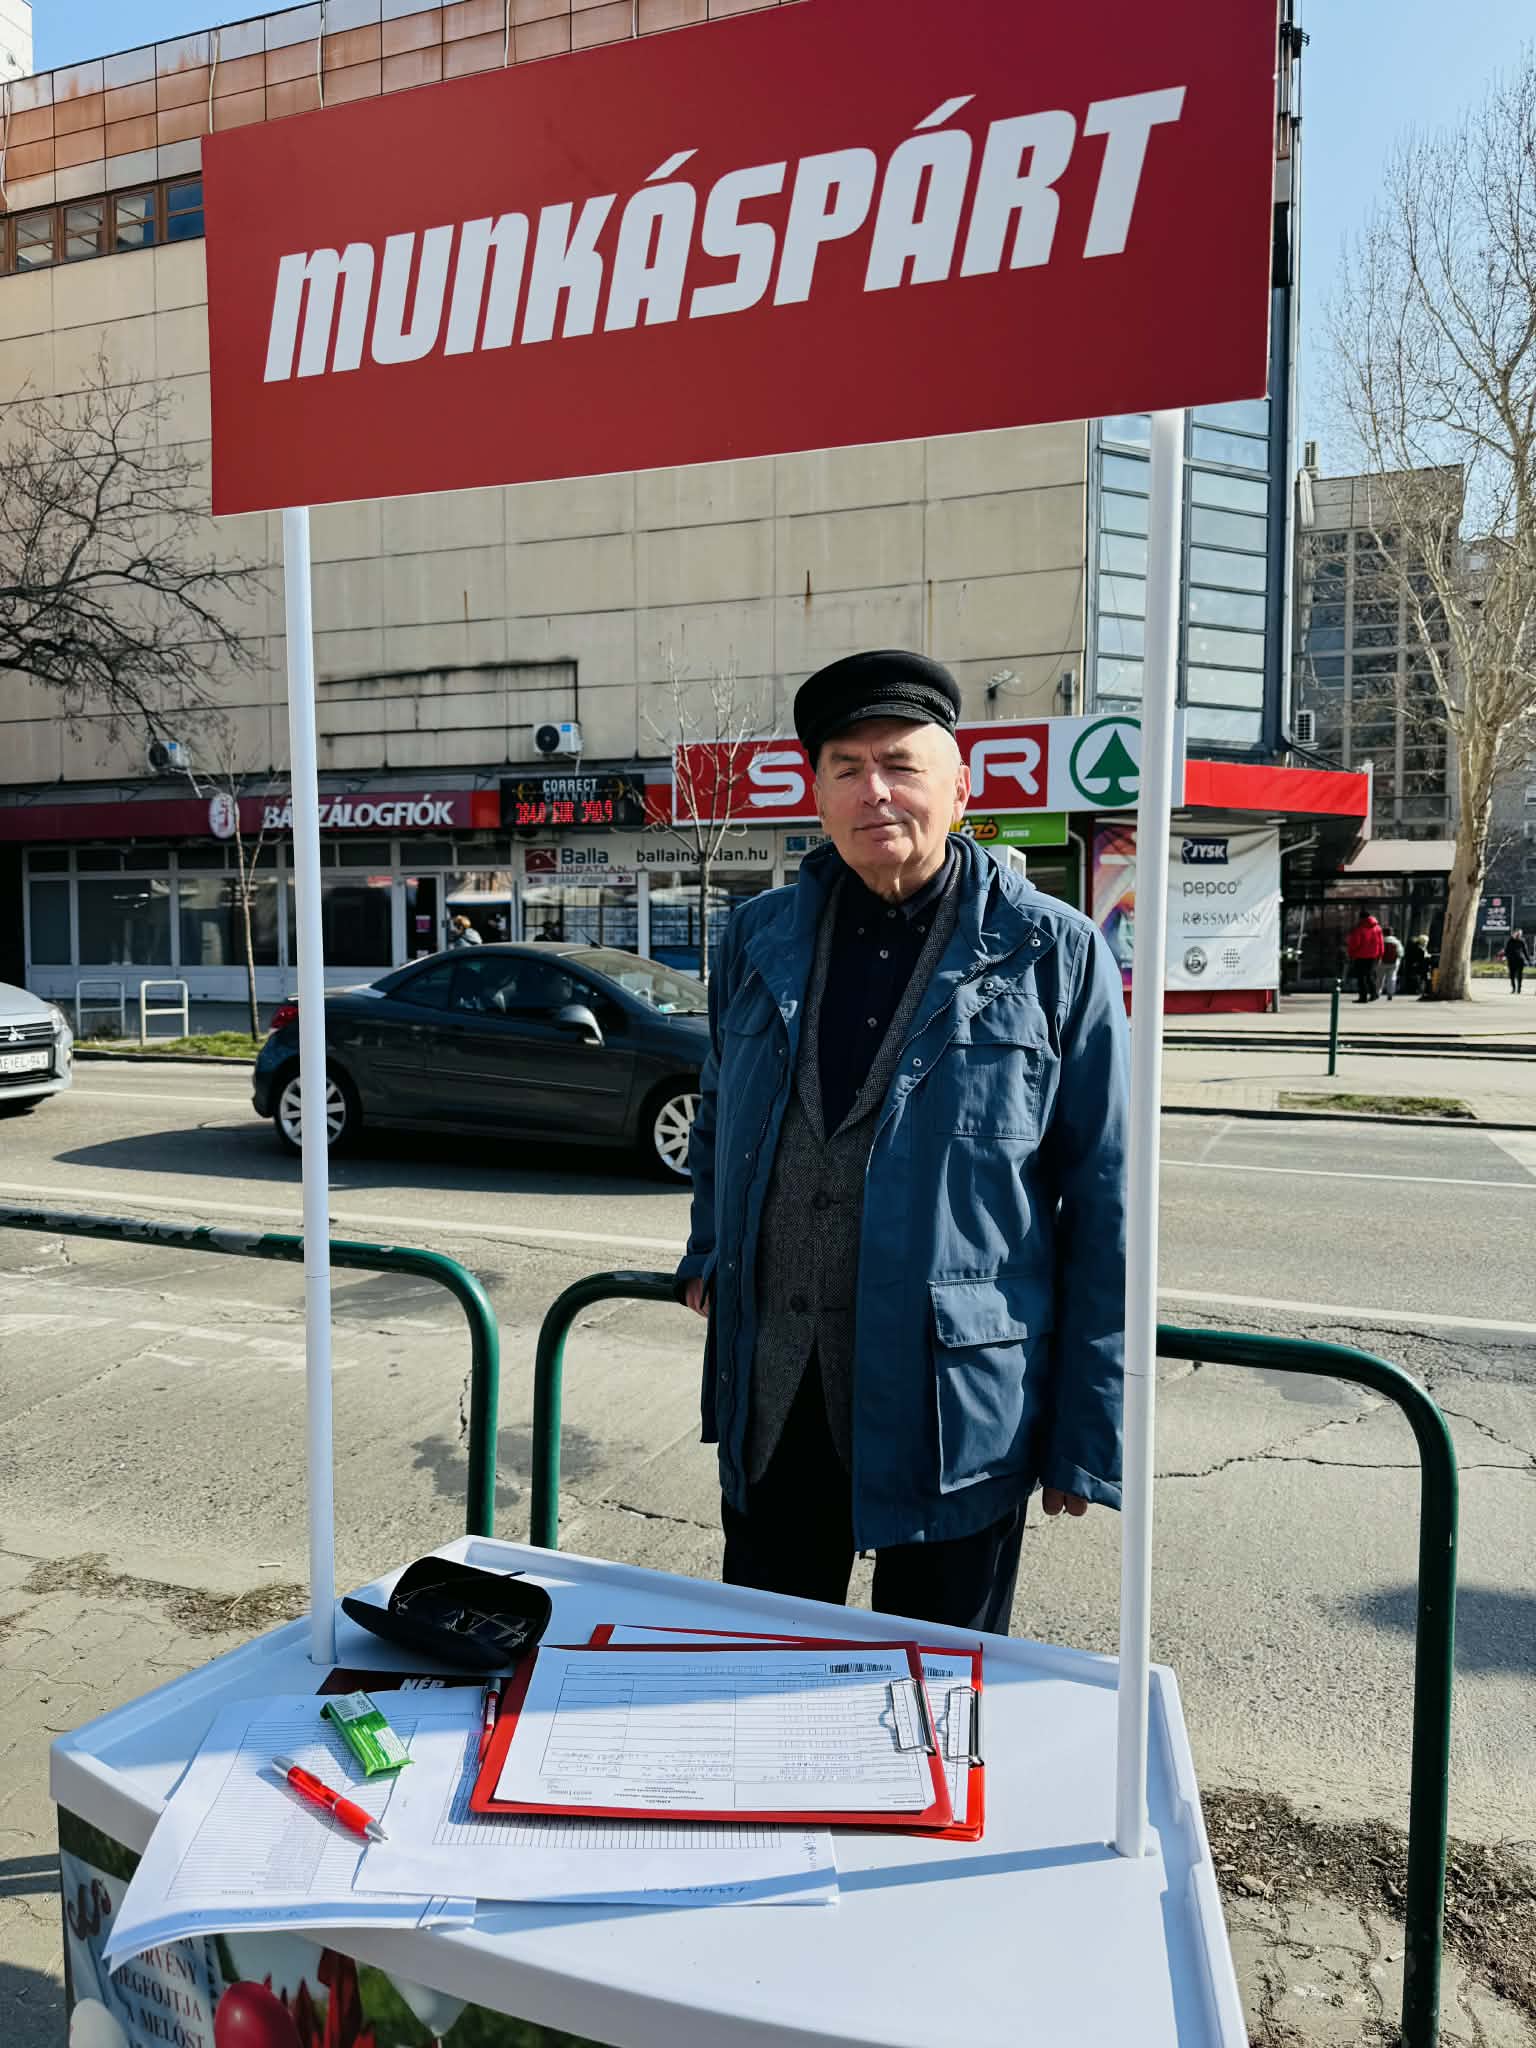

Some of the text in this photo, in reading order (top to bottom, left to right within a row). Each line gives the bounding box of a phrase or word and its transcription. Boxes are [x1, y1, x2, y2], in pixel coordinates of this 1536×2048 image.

[263, 85, 1187, 383] MUNKÁSPÁRT
[747, 736, 1039, 808] SR
[543, 778, 598, 793] CORRECT
[263, 796, 294, 829] BÁ
[319, 794, 454, 828] ZÁLOGFIÓK
[560, 847, 609, 865] Balla
[1191, 843, 1227, 859] JYSK
[1183, 880, 1238, 898] pepco
[1182, 911, 1262, 926] ROSSMANN
